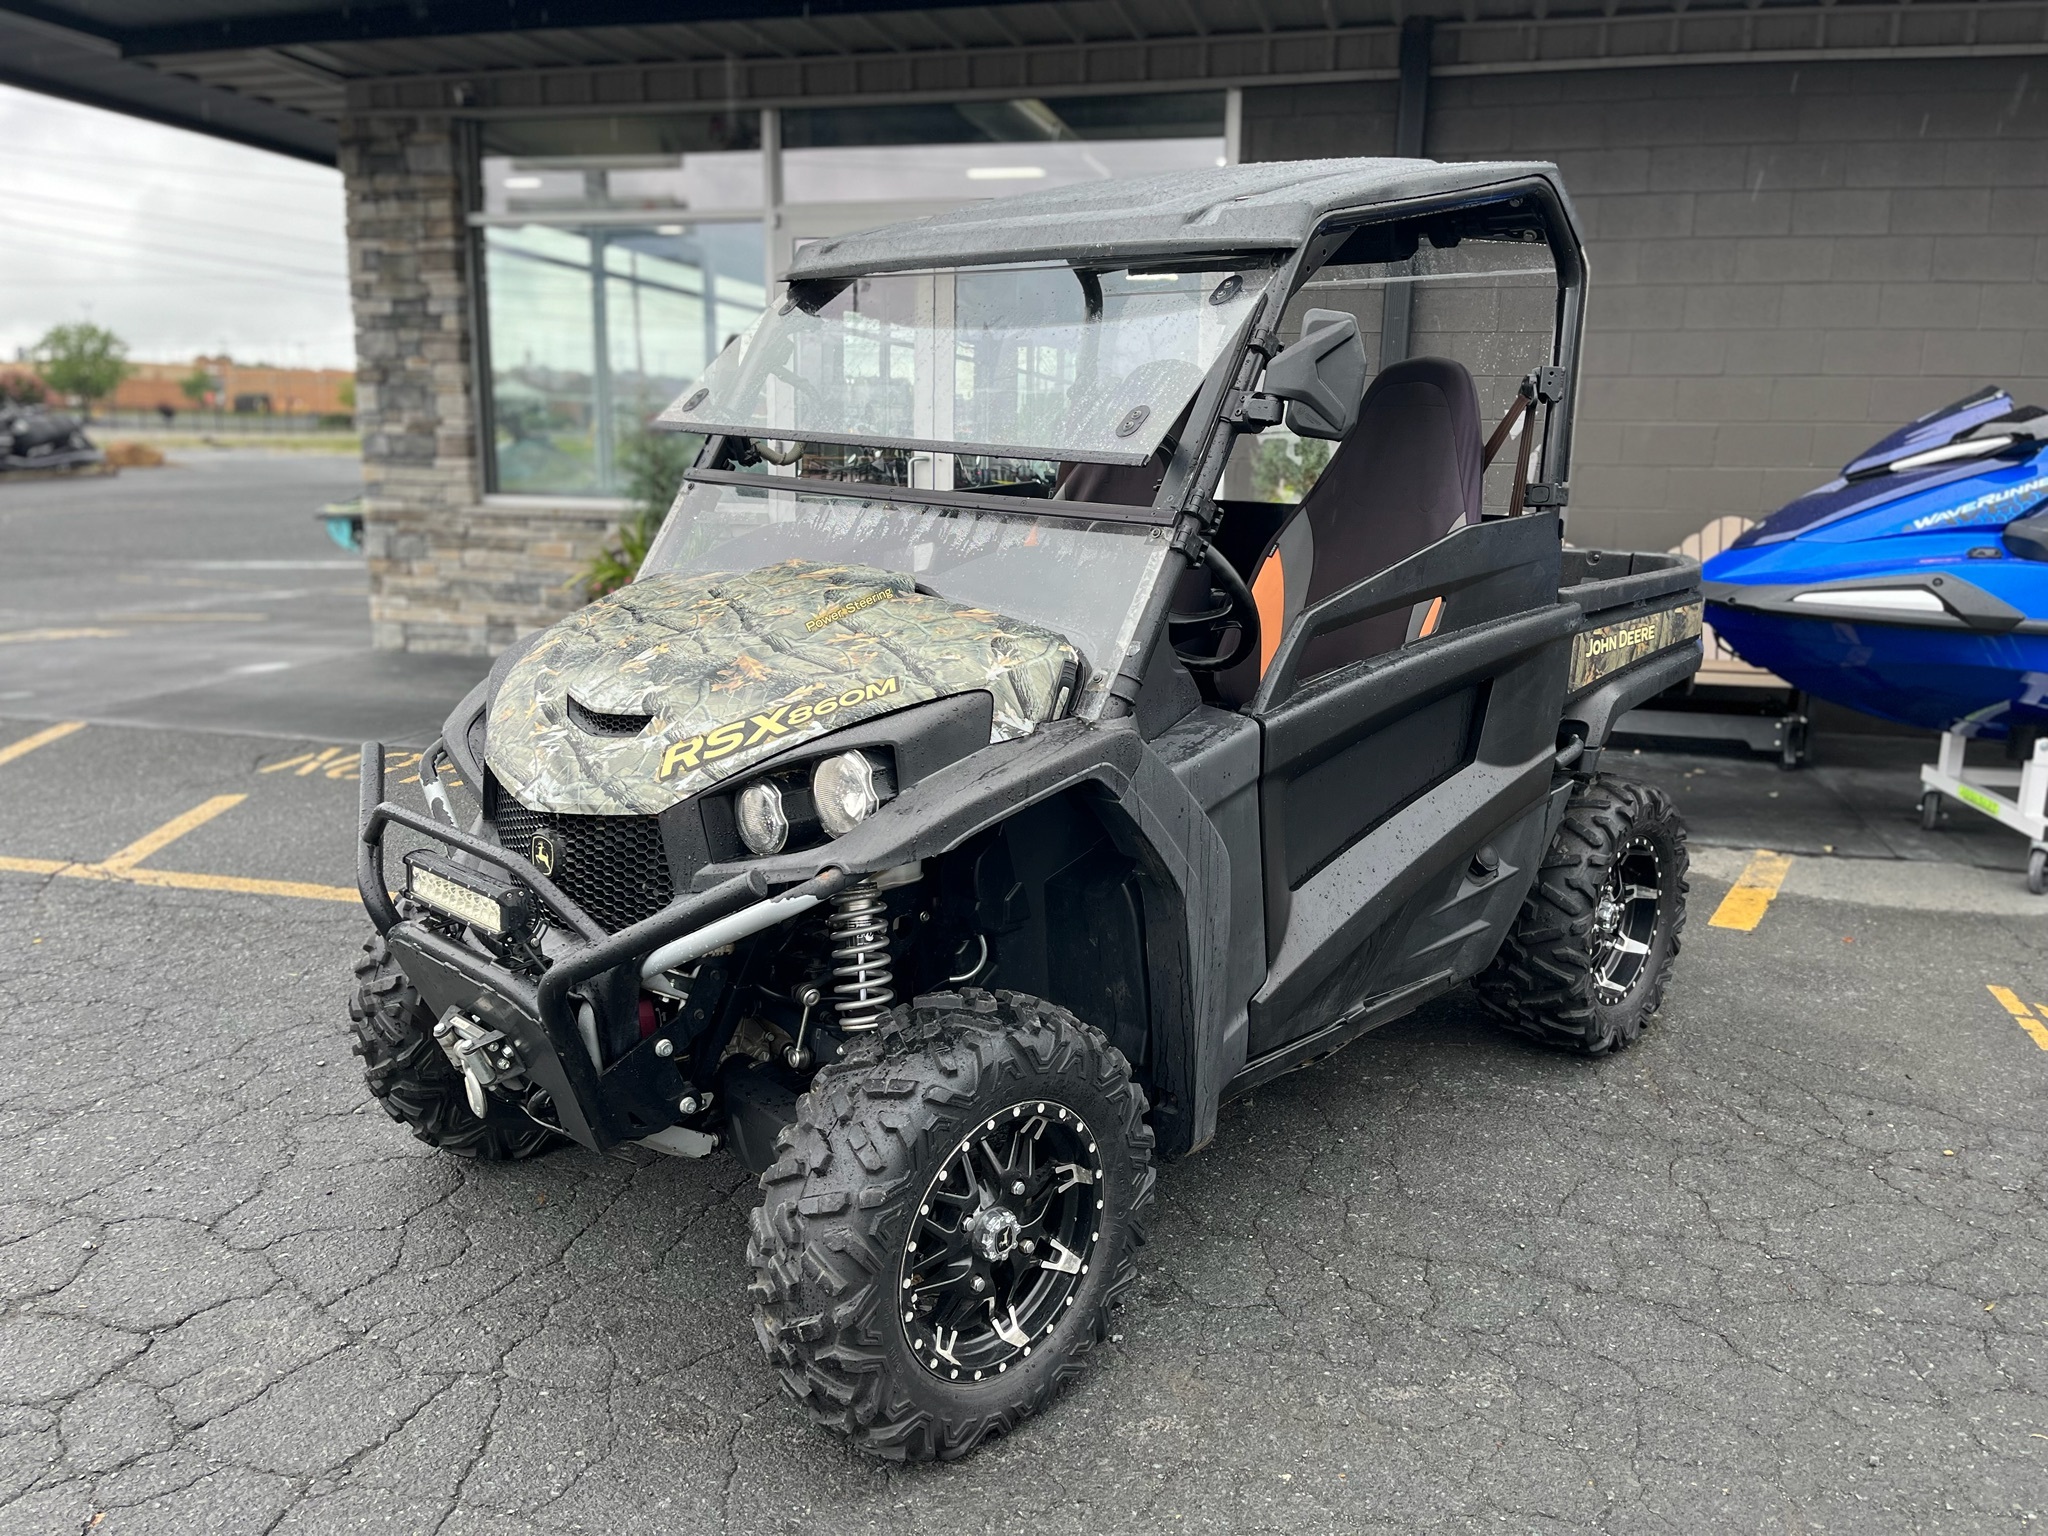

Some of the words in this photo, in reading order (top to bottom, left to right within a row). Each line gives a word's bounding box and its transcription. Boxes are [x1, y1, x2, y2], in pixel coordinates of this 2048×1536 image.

[805, 608, 843, 632] Power
[845, 587, 894, 614] Steering
[1585, 634, 1617, 658] JOHN
[1618, 624, 1656, 649] DEERE
